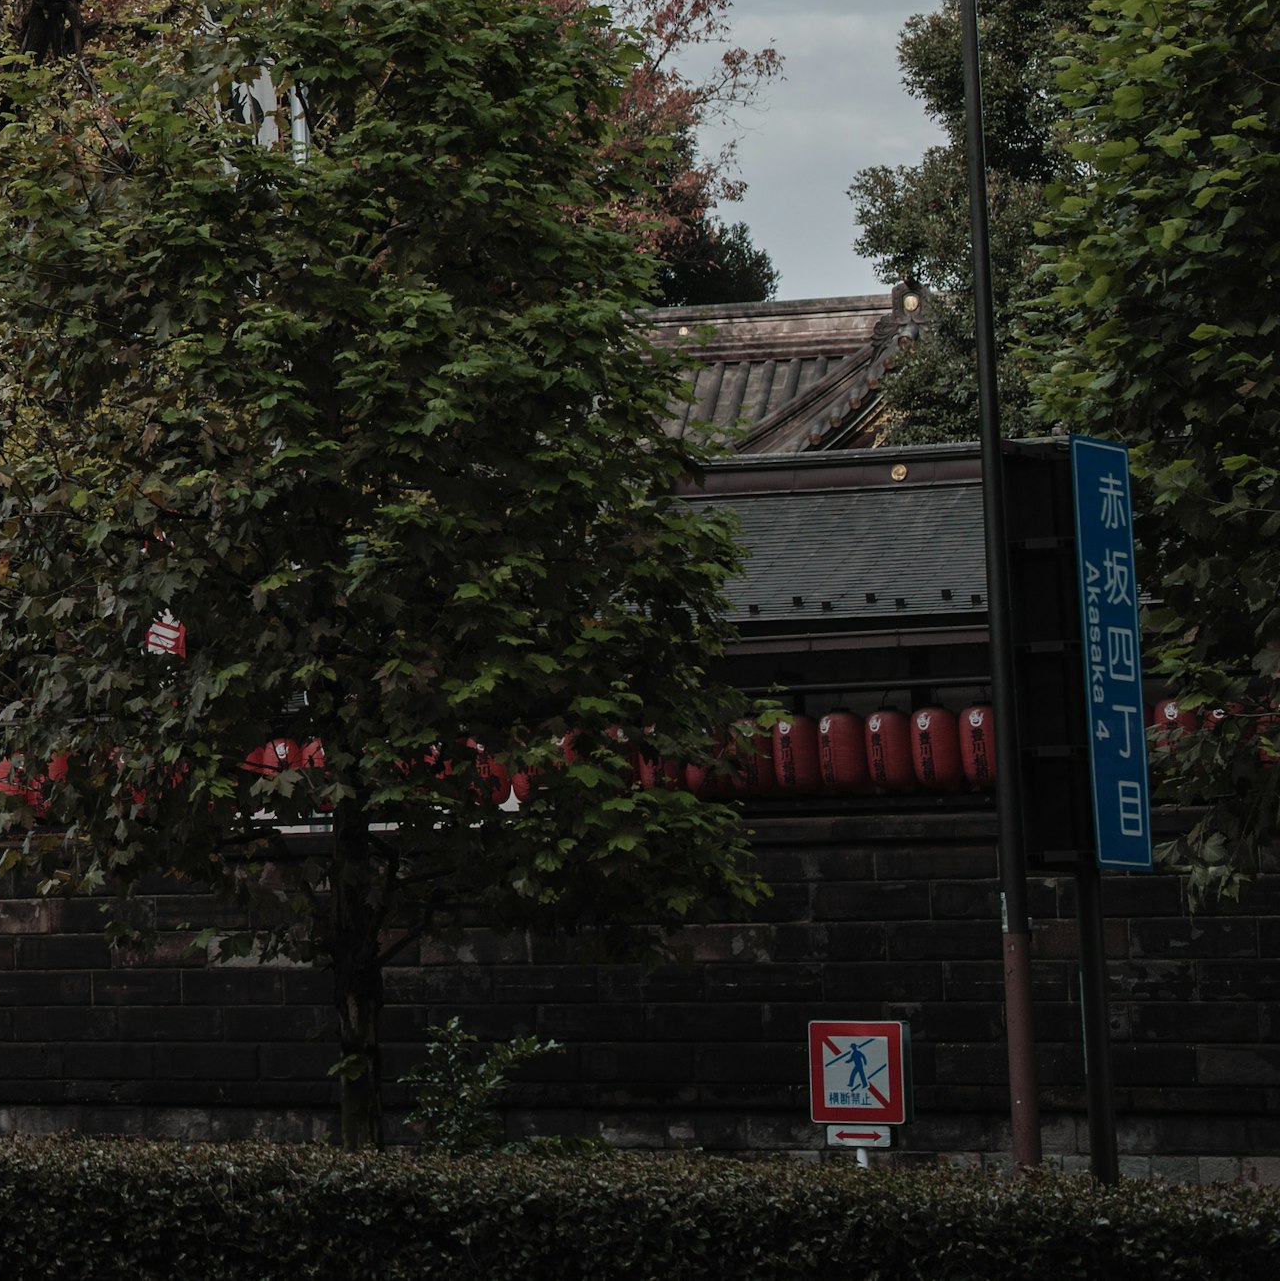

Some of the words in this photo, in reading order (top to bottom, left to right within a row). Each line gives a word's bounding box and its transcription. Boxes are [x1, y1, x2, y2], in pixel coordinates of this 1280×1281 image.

[1085, 560, 1107, 703] Akasaka
[1098, 473, 1143, 836] 赤坂四丁目
[1095, 719, 1110, 741] 4
[829, 1092, 872, 1105] 横断禁止
